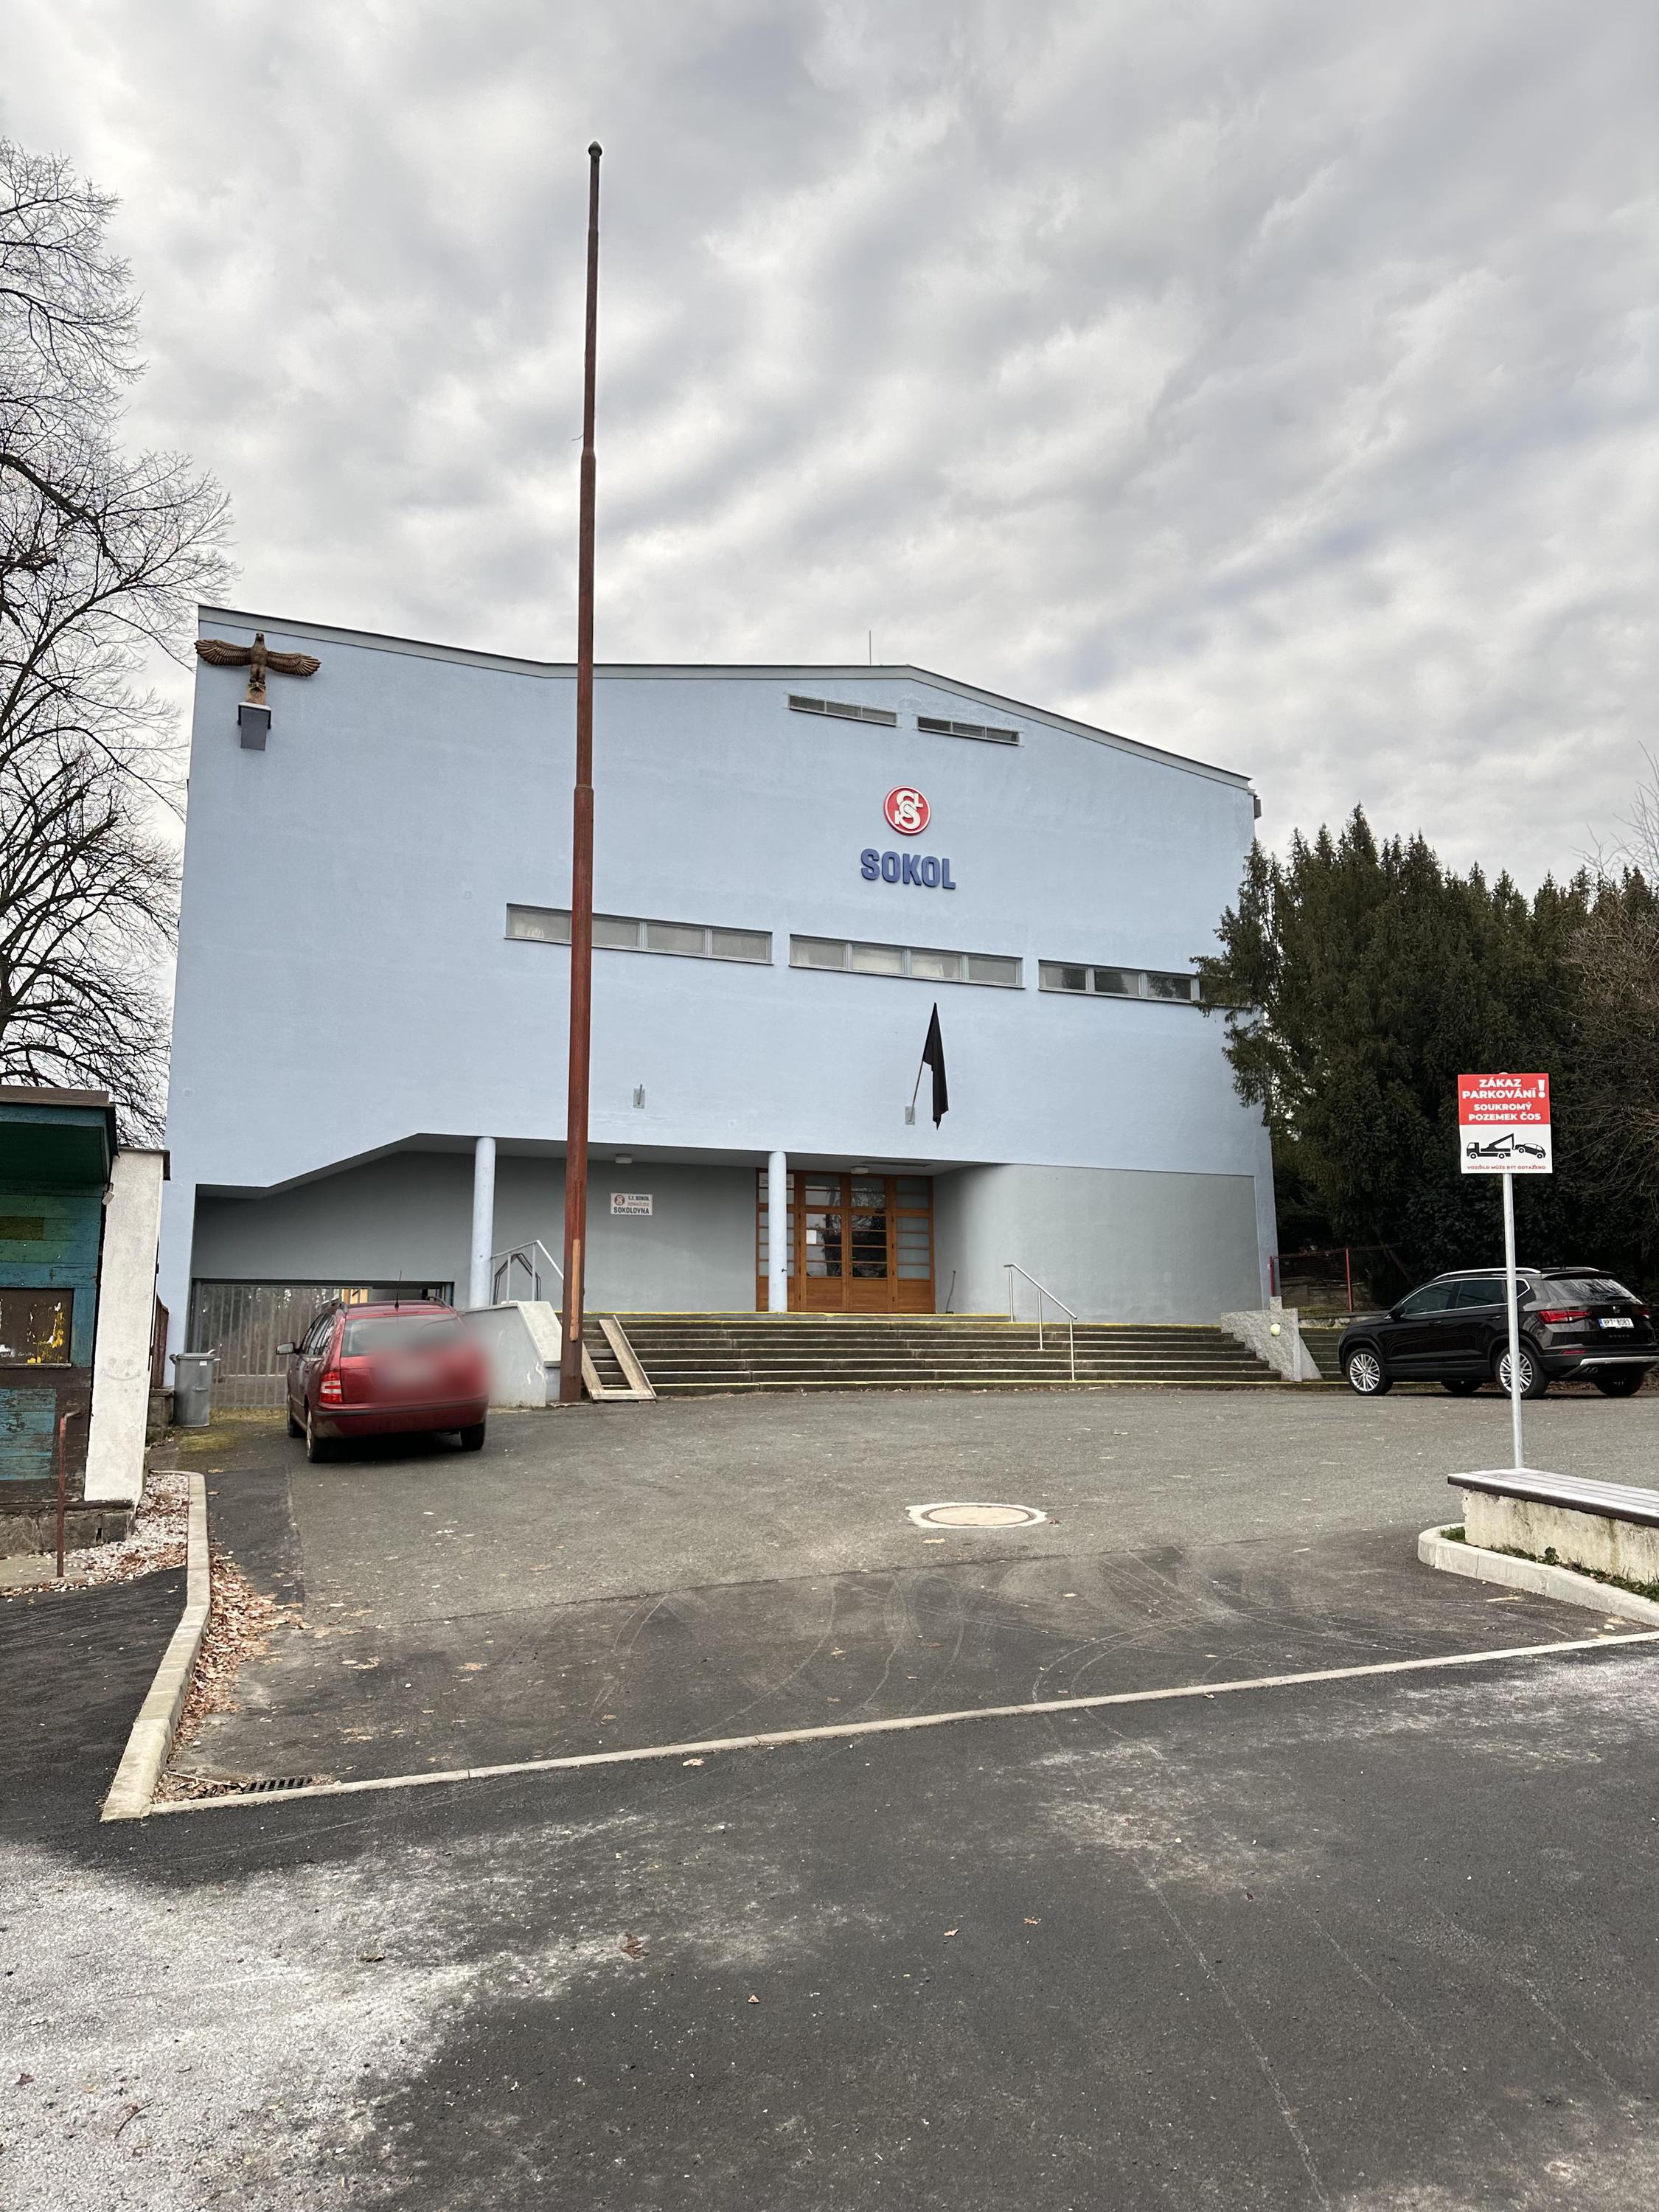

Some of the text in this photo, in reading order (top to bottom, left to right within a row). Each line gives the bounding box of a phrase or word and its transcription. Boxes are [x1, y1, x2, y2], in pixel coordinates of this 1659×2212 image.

[860, 848, 956, 889] SOKOL
[1479, 1077, 1522, 1088] ZÁKAZ
[1462, 1087, 1537, 1099] PARKOVÁNÍ
[1473, 1102, 1532, 1111] SOUKROMÝ
[1468, 1111, 1541, 1121] POZEMEK ČOS
